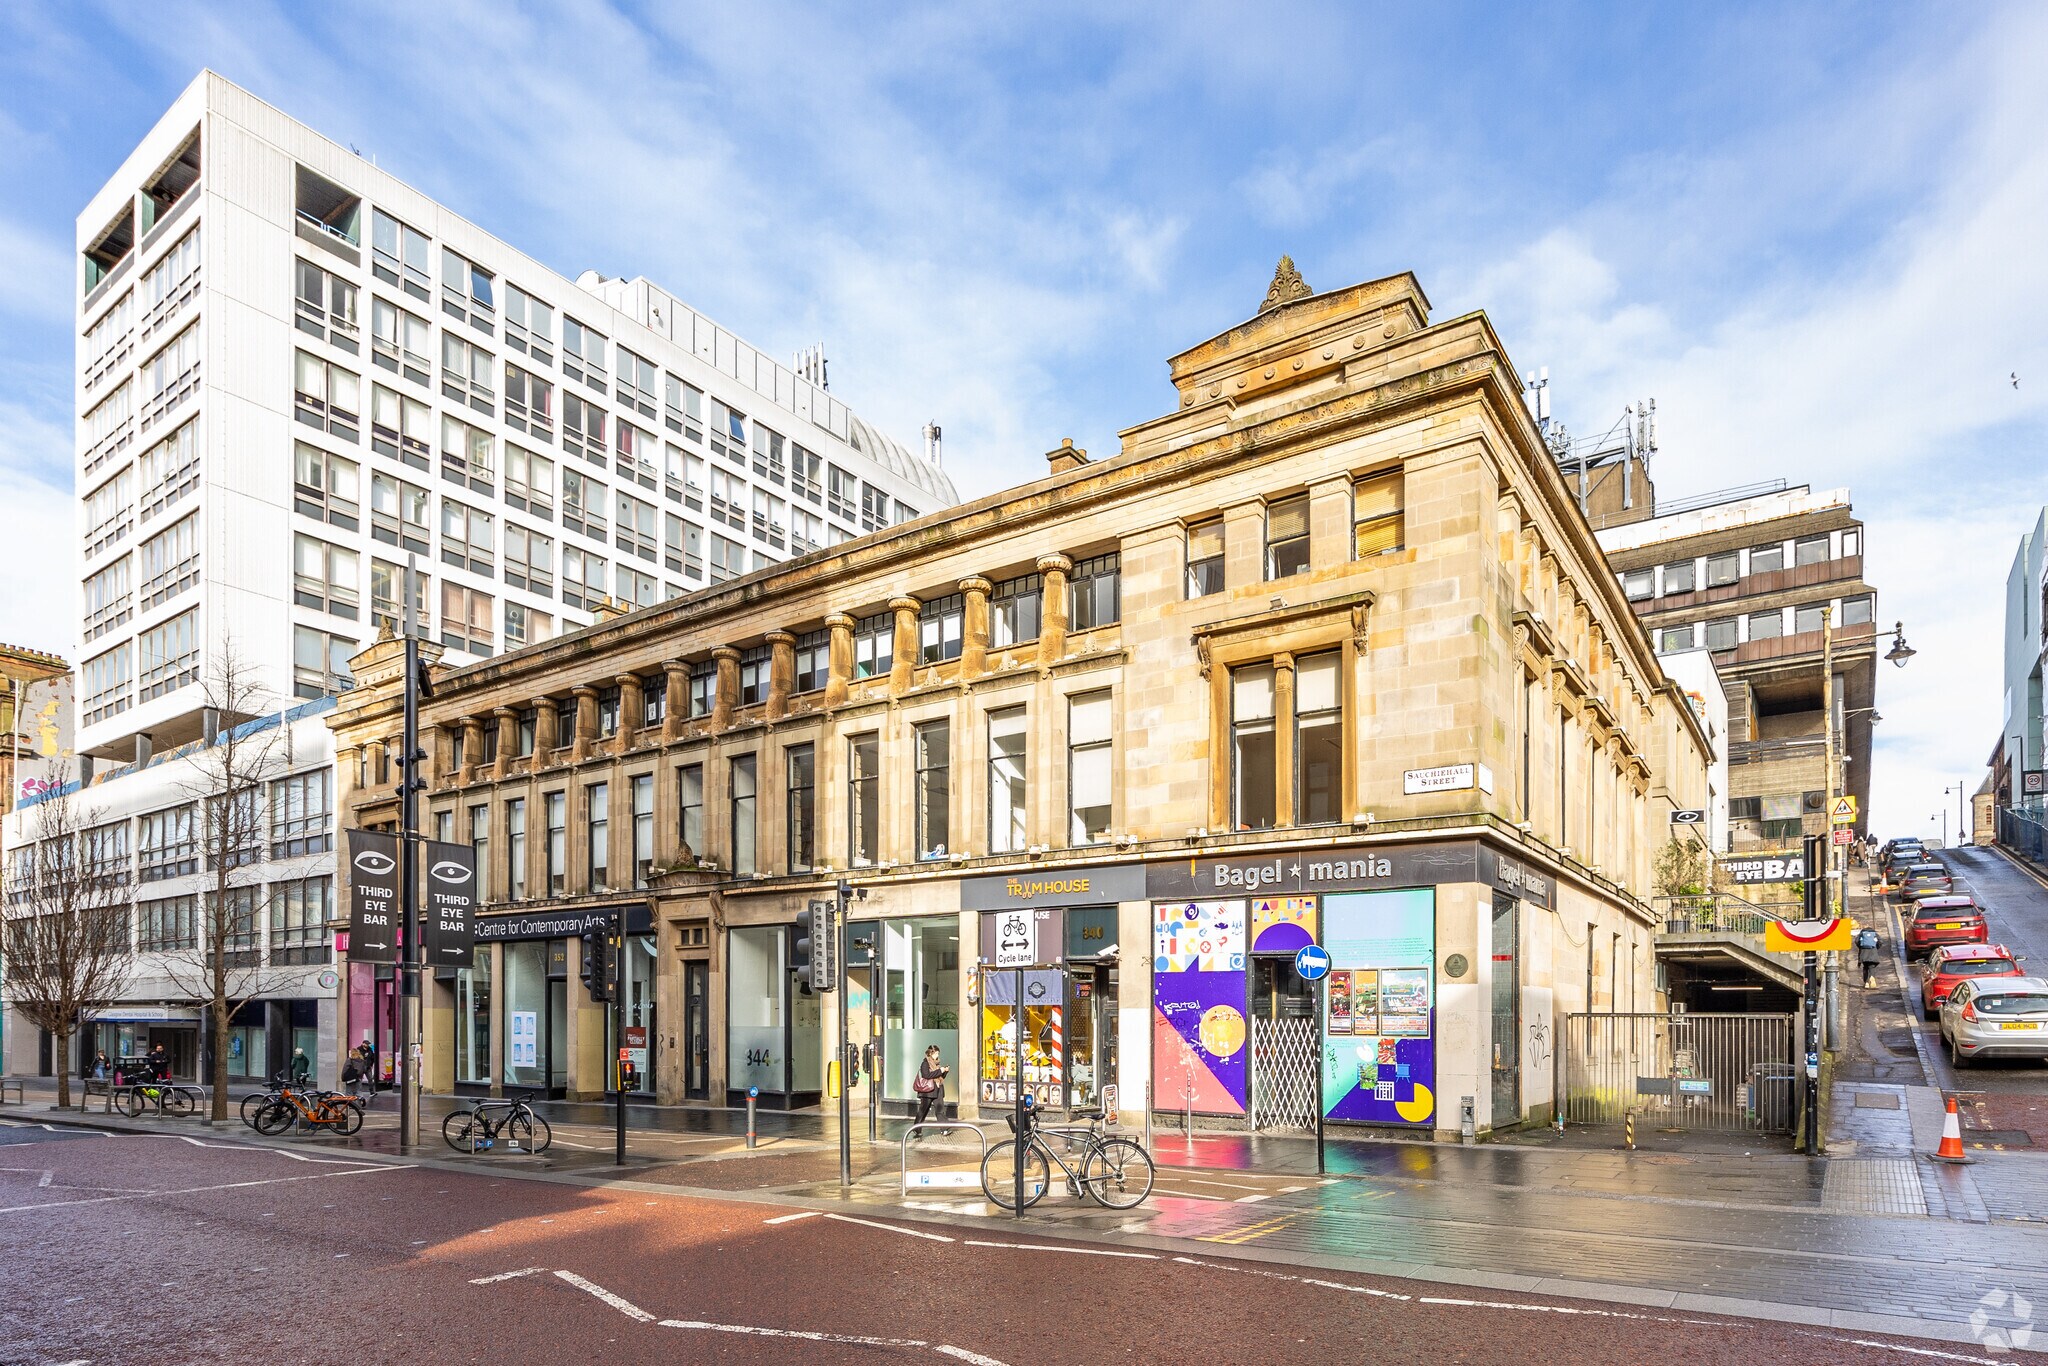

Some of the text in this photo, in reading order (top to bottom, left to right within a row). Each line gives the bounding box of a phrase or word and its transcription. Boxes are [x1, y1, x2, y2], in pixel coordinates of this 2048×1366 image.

[1407, 767, 1470, 779] SAUCHIEHALL
[1421, 777, 1456, 786] STREET
[1214, 853, 1392, 890] Bagel mania
[1719, 858, 1805, 880] THIRD BA
[1498, 856, 1546, 897] Bagel mania
[1736, 870, 1763, 881] EYE
[358, 885, 393, 898] THIRD
[1044, 879, 1090, 894] HOUSE
[434, 893, 470, 906] THIRD
[365, 900, 387, 912] EYE
[441, 907, 464, 919] EYE
[363, 914, 388, 925] BAR
[440, 921, 464, 932] BAR
[508, 920, 520, 934] for
[520, 917, 584, 935] Contemporary
[1083, 927, 1104, 939] 340
[554, 952, 565, 962] 352
[998, 953, 1032, 964] Cycle lane
[747, 1049, 770, 1066] 344
